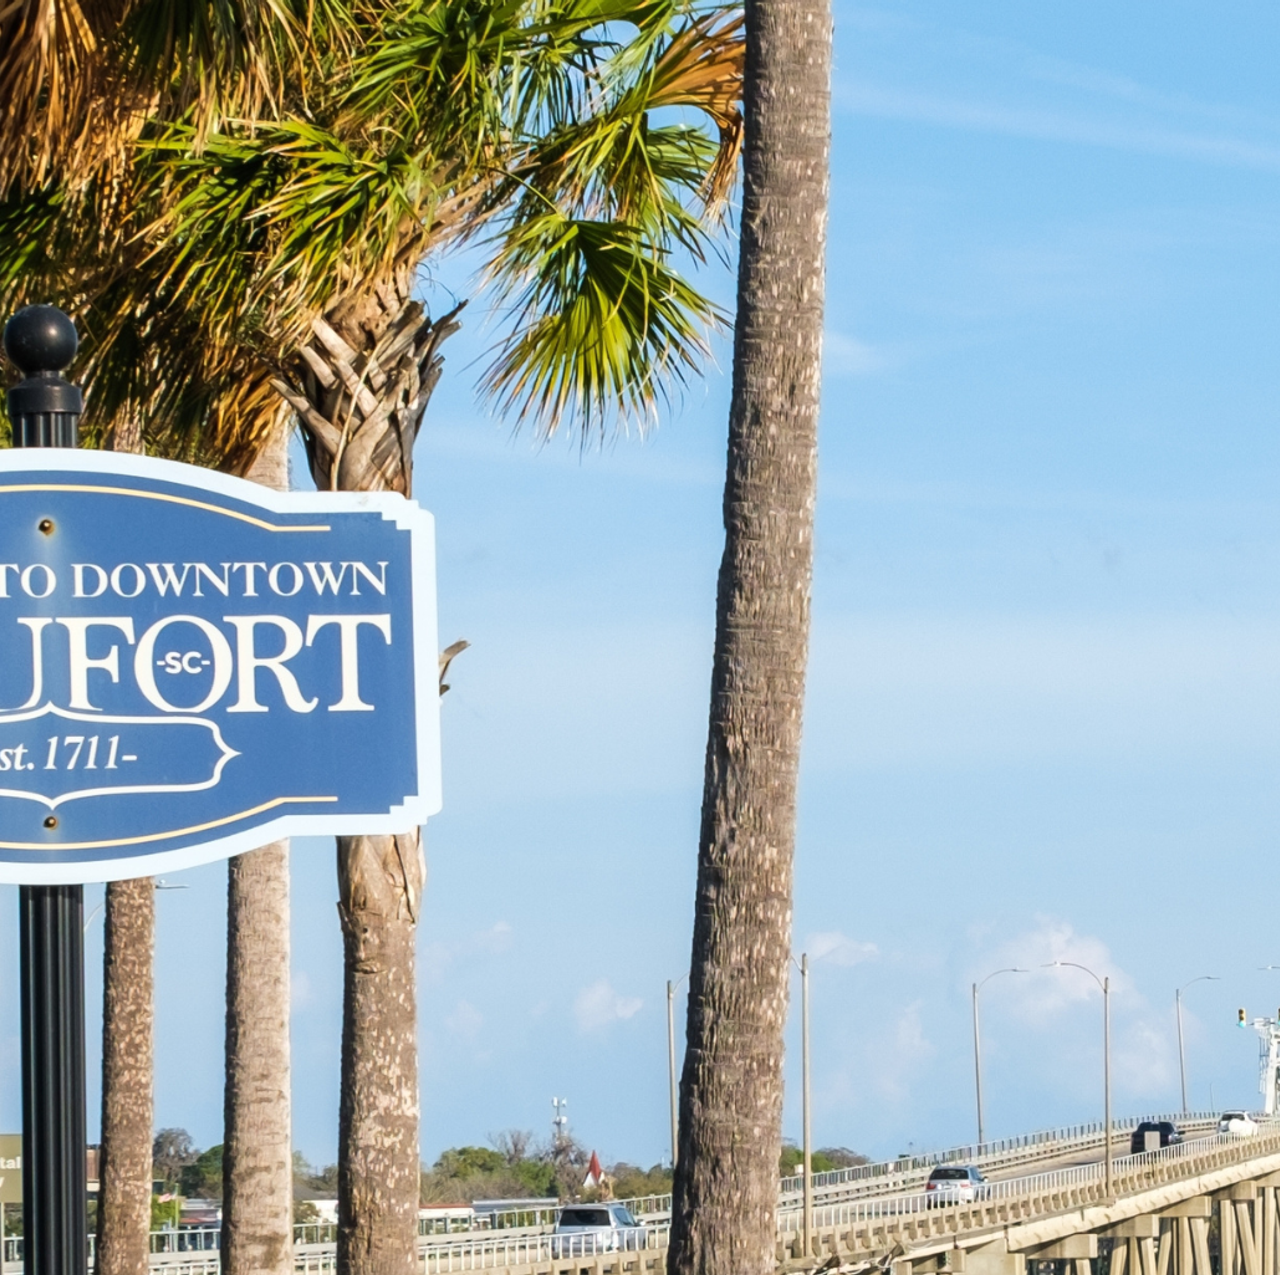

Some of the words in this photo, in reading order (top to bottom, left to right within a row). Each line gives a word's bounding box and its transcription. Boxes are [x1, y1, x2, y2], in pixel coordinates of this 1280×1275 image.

[71, 562, 389, 597] DOWNTOWN
[156, 651, 211, 674] -SC-
[44, 735, 138, 770] 1711-
